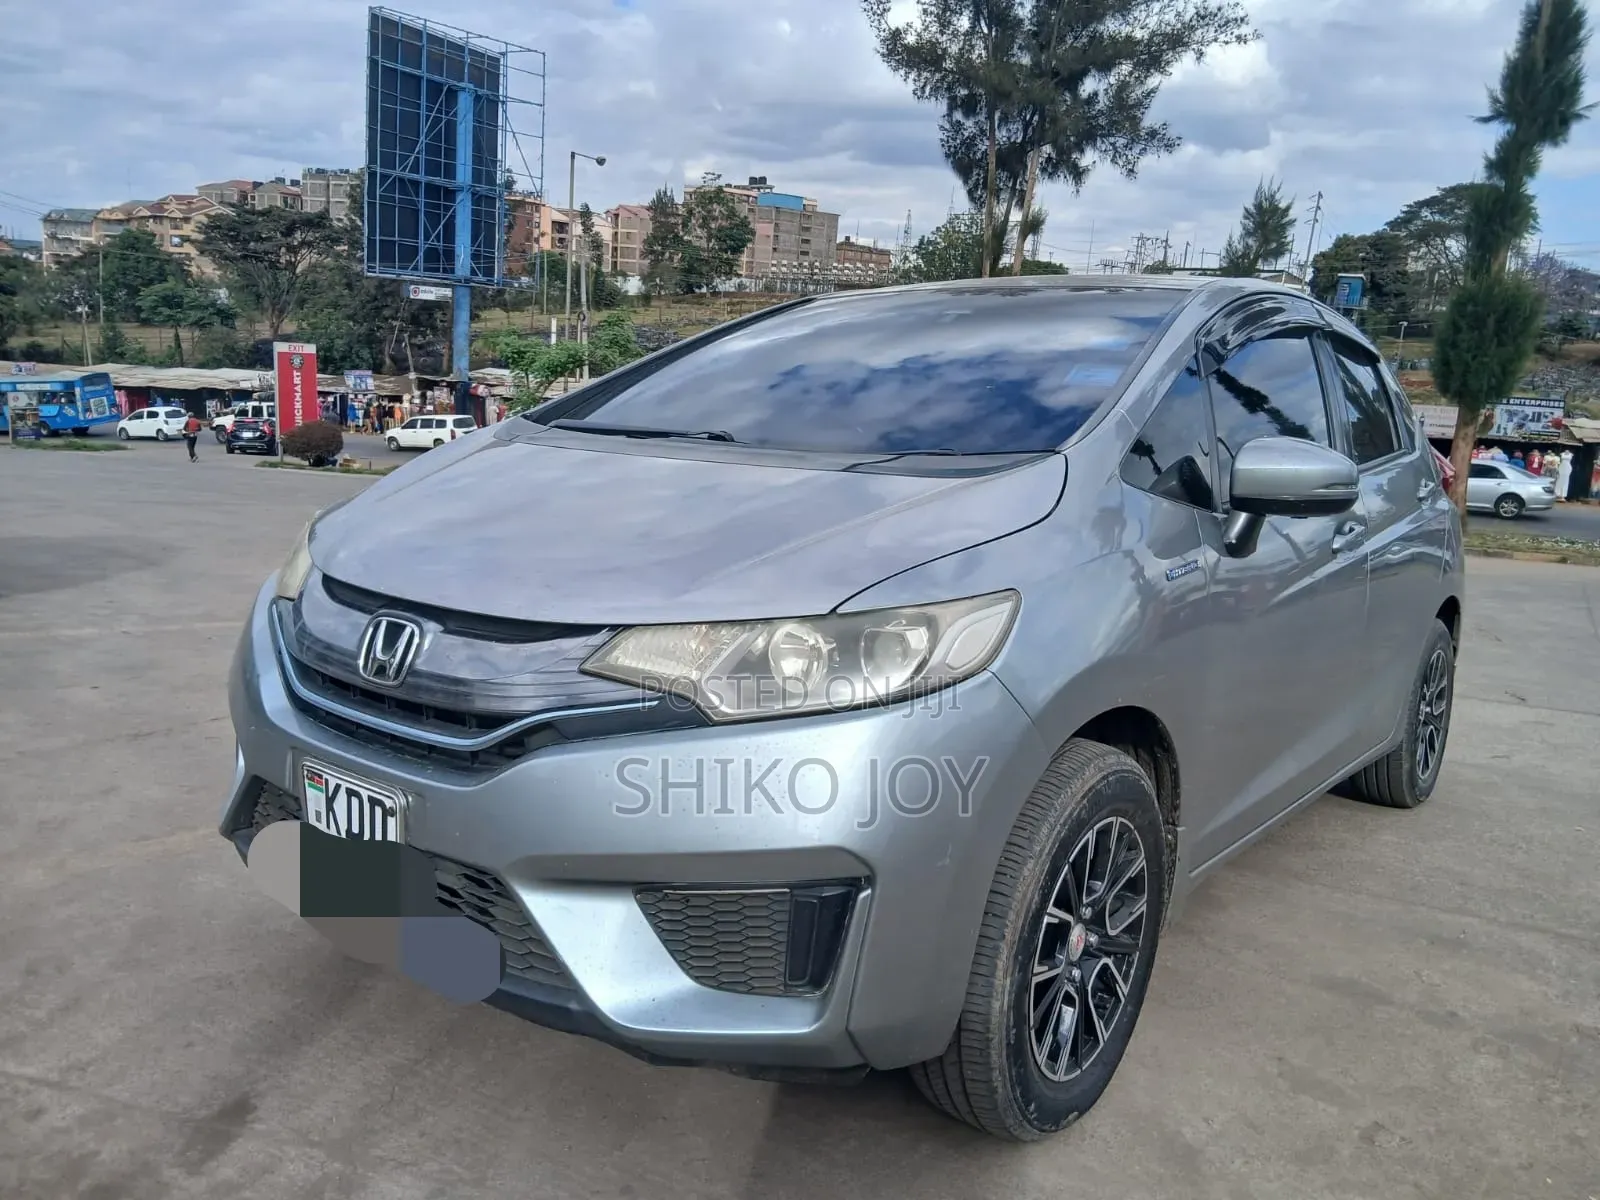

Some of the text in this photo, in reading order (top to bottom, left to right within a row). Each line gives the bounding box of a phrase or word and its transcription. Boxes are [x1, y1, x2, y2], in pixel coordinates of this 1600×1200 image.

[288, 344, 304, 352] EXIT
[293, 370, 303, 427] UICKMART
[1509, 398, 1565, 408] ENTERPRISES
